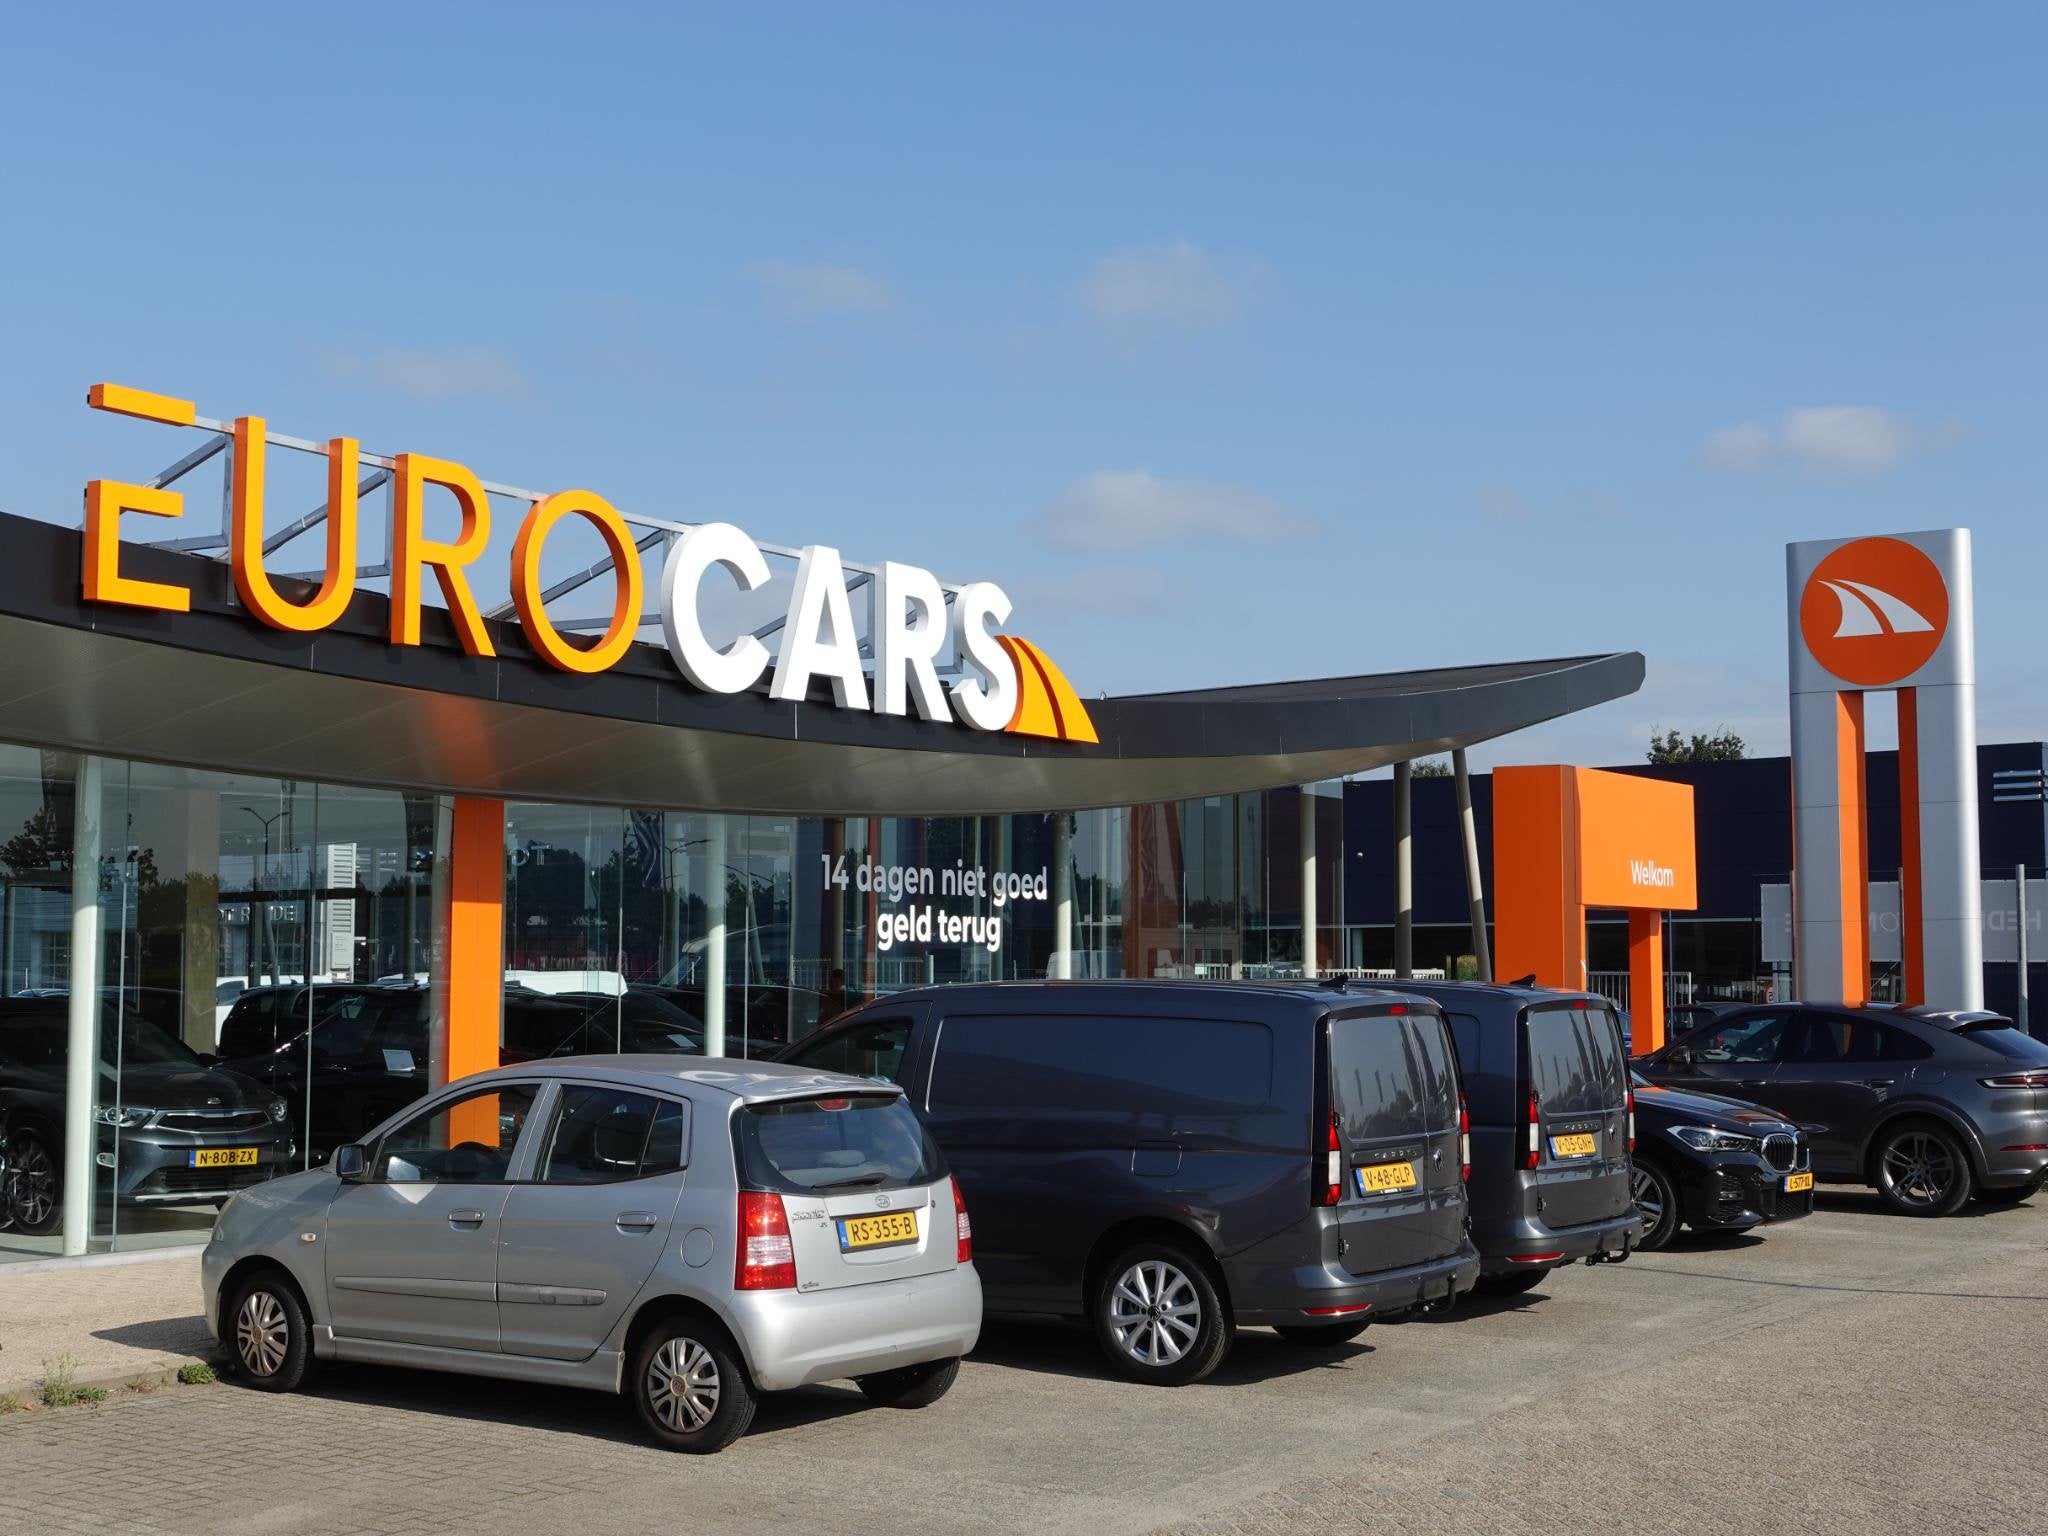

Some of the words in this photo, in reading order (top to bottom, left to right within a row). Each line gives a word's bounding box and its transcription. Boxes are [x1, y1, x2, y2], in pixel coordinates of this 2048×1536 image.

[82, 382, 1019, 731] EUROCARS
[821, 854, 849, 891] 14
[856, 855, 934, 902] dagen
[942, 858, 986, 897] niet
[993, 866, 1048, 907] goed
[1630, 859, 1675, 887] Welkom
[877, 905, 932, 951] geld
[937, 909, 1001, 953] terug
[200, 1151, 254, 1165] N-808-ZX
[1365, 1166, 1411, 1187] V-48-GLP
[851, 1216, 913, 1242] RS-355-B
